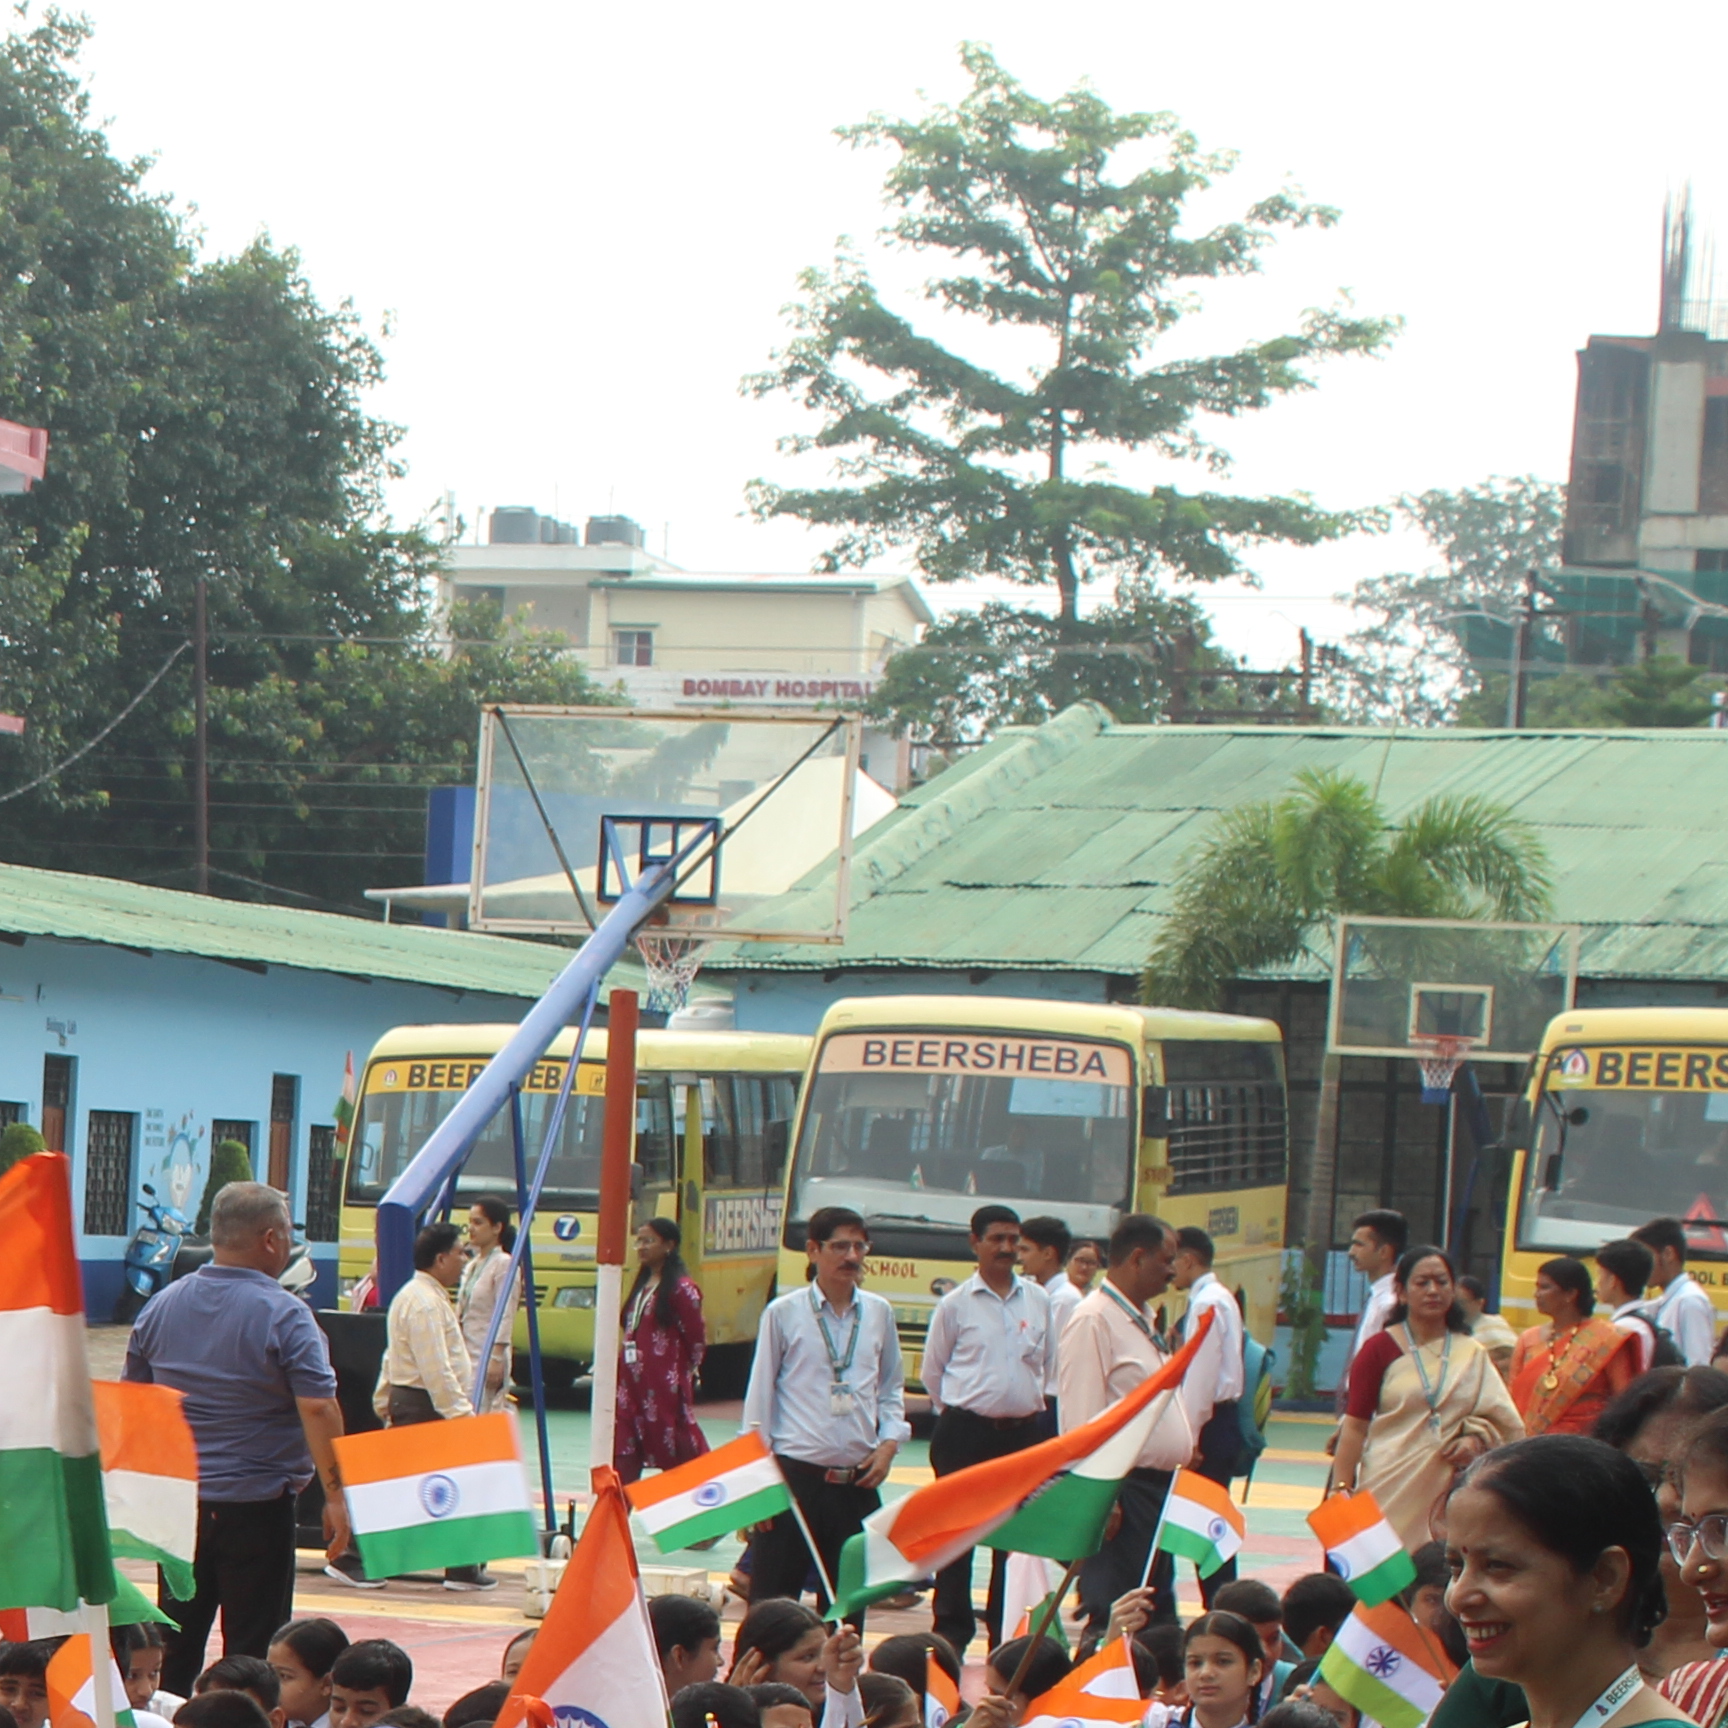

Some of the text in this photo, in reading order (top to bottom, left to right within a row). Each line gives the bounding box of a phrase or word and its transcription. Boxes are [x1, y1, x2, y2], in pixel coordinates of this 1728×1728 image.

[683, 679, 769, 697] BOMBAY
[862, 1039, 1107, 1077] BEERSHEBA
[408, 1064, 577, 1091] BEEREB
[559, 1217, 575, 1238] 7
[863, 1260, 918, 1278] SCHOOL
